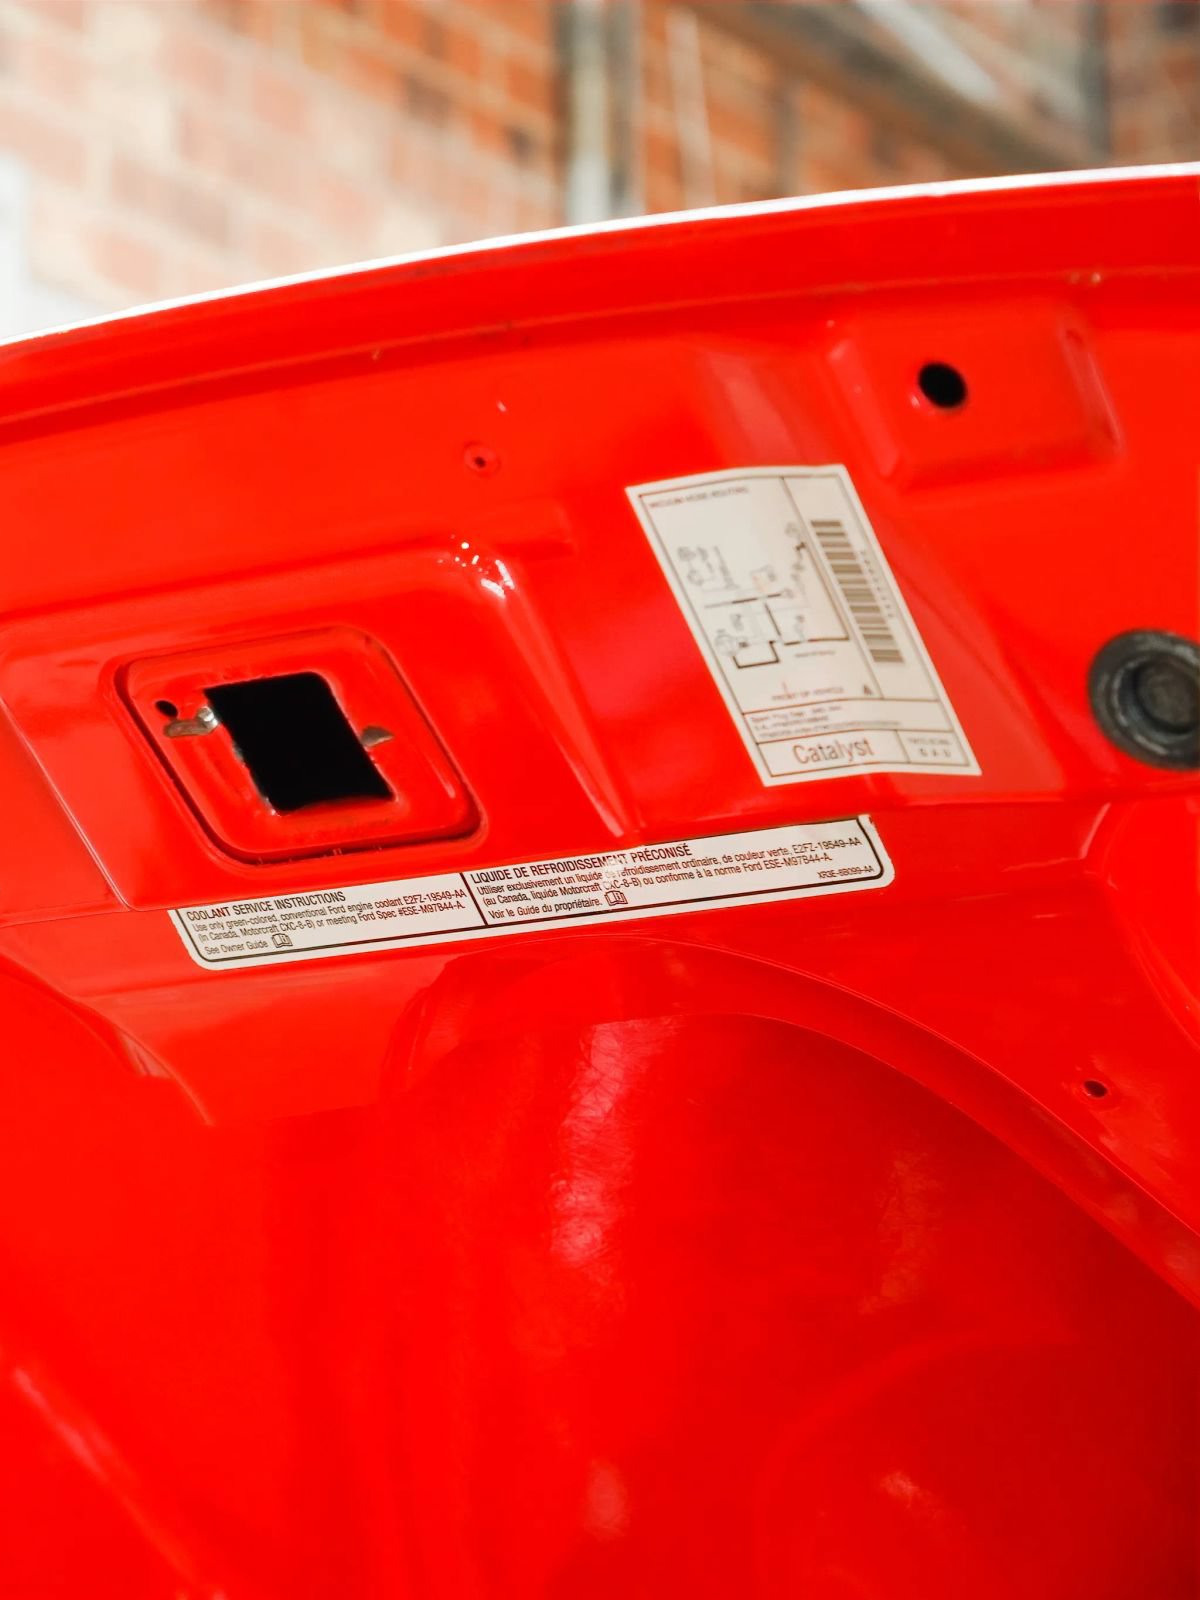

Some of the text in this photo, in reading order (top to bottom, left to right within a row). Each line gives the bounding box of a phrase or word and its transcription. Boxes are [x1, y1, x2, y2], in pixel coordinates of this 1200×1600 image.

[792, 738, 875, 765] Catalyst
[470, 869, 513, 884] LIQUIDE
[512, 866, 530, 879] DE
[630, 843, 692, 863] PRÉCONISÉ
[476, 885, 505, 896] Utiliser
[506, 876, 564, 892] exclusivement
[563, 876, 576, 885] un
[575, 871, 603, 883] liquide
[681, 856, 722, 869] ordinaire,
[721, 854, 734, 864] de
[734, 850, 766, 862] couleur
[766, 847, 793, 857] verte,
[792, 837, 862, 854] E2FZ-19549-AA
[482, 897, 497, 907] (au
[496, 892, 531, 904] Canada,
[530, 888, 559, 901] liquide
[558, 882, 602, 896] Motorcraft
[642, 877, 655, 885] ou
[655, 871, 695, 884] conforme
[695, 868, 704, 879] à
[702, 868, 714, 877] la
[713, 865, 742, 876] norme
[741, 861, 763, 872] Ford
[186, 891, 346, 921] COOLANT SERVICE INSTRUCTIONS
[191, 889, 467, 933] Use only green-colored, conventional Ford engine coolant E2FZ-19549-AA
[487, 898, 602, 919] Voir le Guide du propriétaire.
[209, 930, 241, 941] Canada,
[239, 924, 280, 936] Motorcraft
[279, 919, 316, 932] CXC-8-B)
[315, 919, 325, 928] or
[325, 915, 358, 926] meeting
[357, 911, 376, 922] Ford
[375, 910, 397, 920] Spec
[204, 940, 269, 955] See Owner Guide
